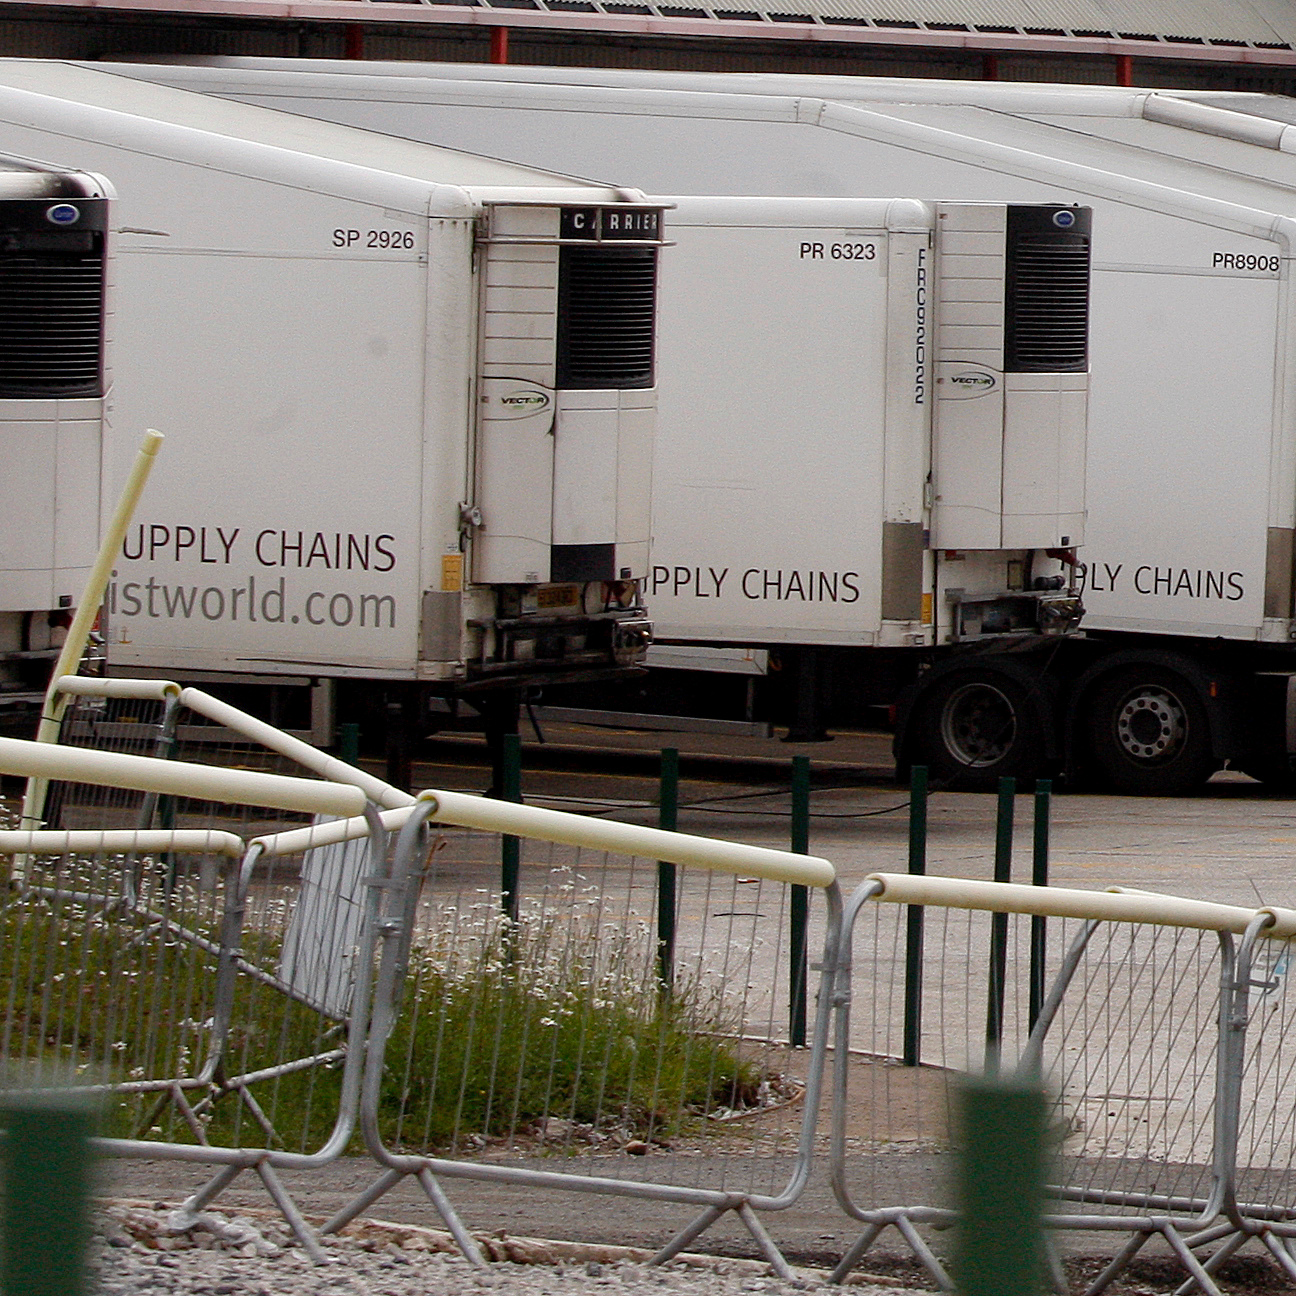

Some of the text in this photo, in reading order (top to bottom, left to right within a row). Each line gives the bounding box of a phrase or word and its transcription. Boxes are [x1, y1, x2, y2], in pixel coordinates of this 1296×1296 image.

[332, 229, 415, 249] SP 2926
[799, 242, 876, 260] PR 6323
[1212, 252, 1280, 272] PR8908
[951, 376, 992, 385] VECTOR
[502, 395, 546, 405] VECTOR
[122, 523, 240, 565] UPPLY
[254, 529, 397, 573] CHAINS
[643, 565, 860, 603] PPLY CHAINS
[1133, 565, 1245, 602] CHAINS
